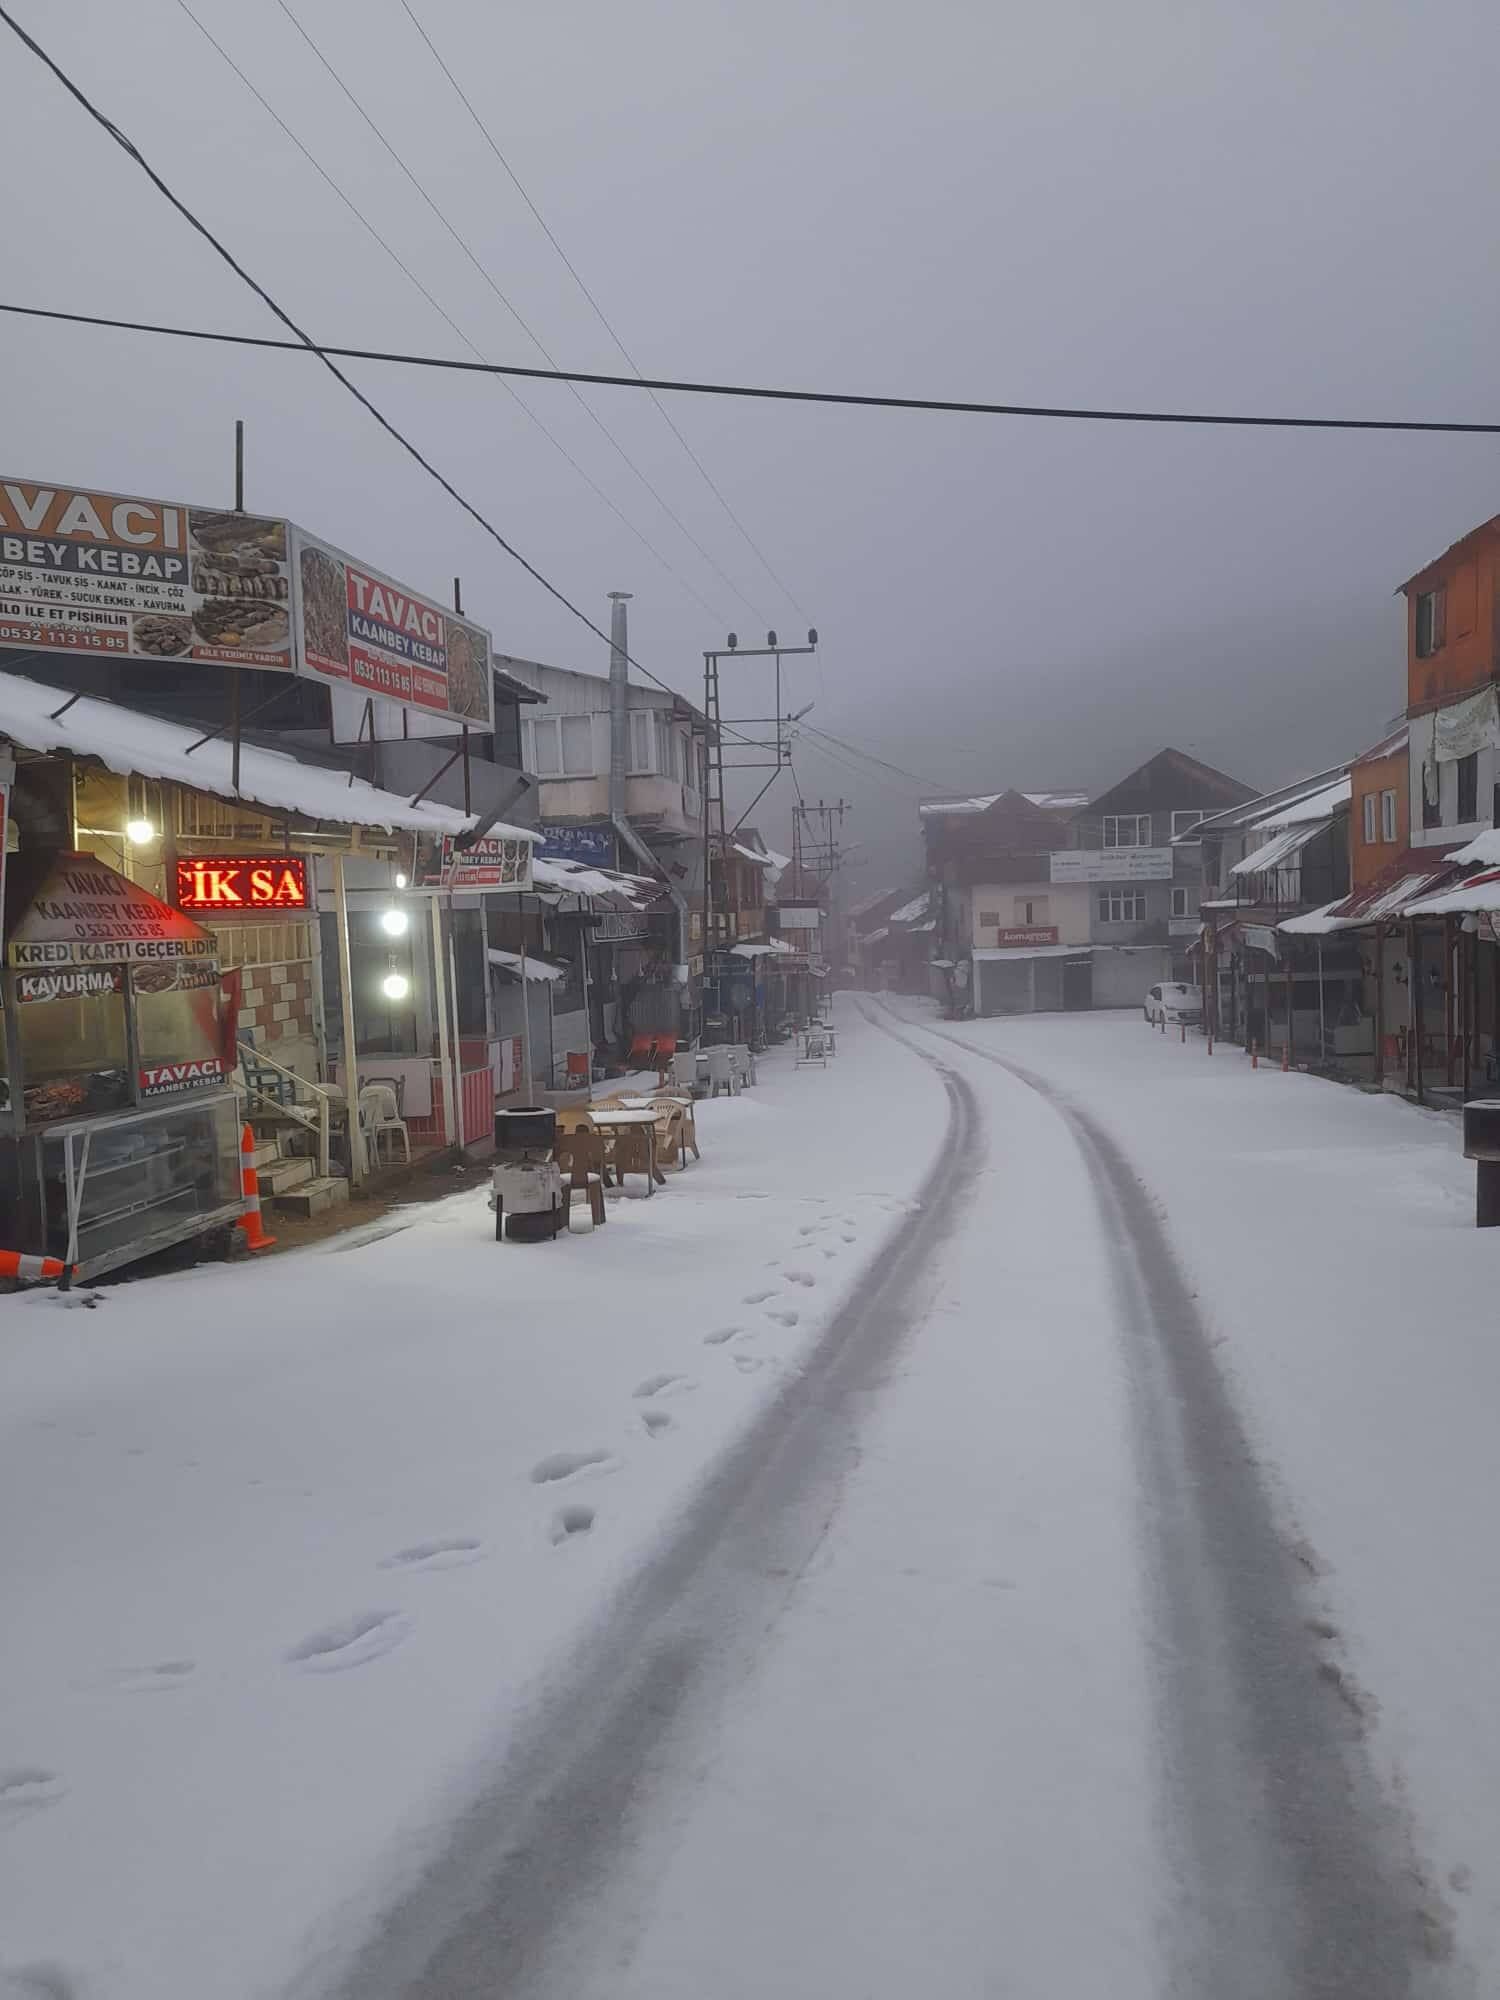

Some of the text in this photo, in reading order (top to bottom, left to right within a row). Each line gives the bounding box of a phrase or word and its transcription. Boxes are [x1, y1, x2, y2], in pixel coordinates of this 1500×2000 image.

[0, 485, 179, 549] VACI
[77, 547, 183, 579] KEBAP
[41, 573, 72, 586] TAVUK
[97, 579, 128, 592] KANAT
[31, 585, 62, 600] YÜREK
[70, 591, 102, 604] SUCUK
[103, 594, 136, 608] EKMEK
[143, 598, 187, 613] KAVURMA
[350, 573, 444, 646] TAVACI
[49, 607, 65, 620] ET
[0, 626, 42, 641] 0532
[47, 631, 78, 645] 113
[83, 634, 102, 647] 15
[106, 636, 126, 648] 85
[352, 614, 410, 655] KAANBEY
[411, 640, 446, 667] KEBAP
[376, 665, 390, 687] 113
[391, 671, 400, 689] 15
[63, 871, 127, 897] TAVACI
[250, 868, 304, 901] SA
[33, 901, 174, 921] KAANBEY KEBAP
[87, 923, 114, 937] 532
[134, 923, 146, 936] 15
[80, 942, 131, 960] KARTI
[135, 939, 218, 959] GEÇERLİDİR
[22, 971, 115, 996] KAVURMA
[144, 1060, 222, 1085] TAVACI
[145, 1074, 223, 1097] KAANBEY KEBAP
